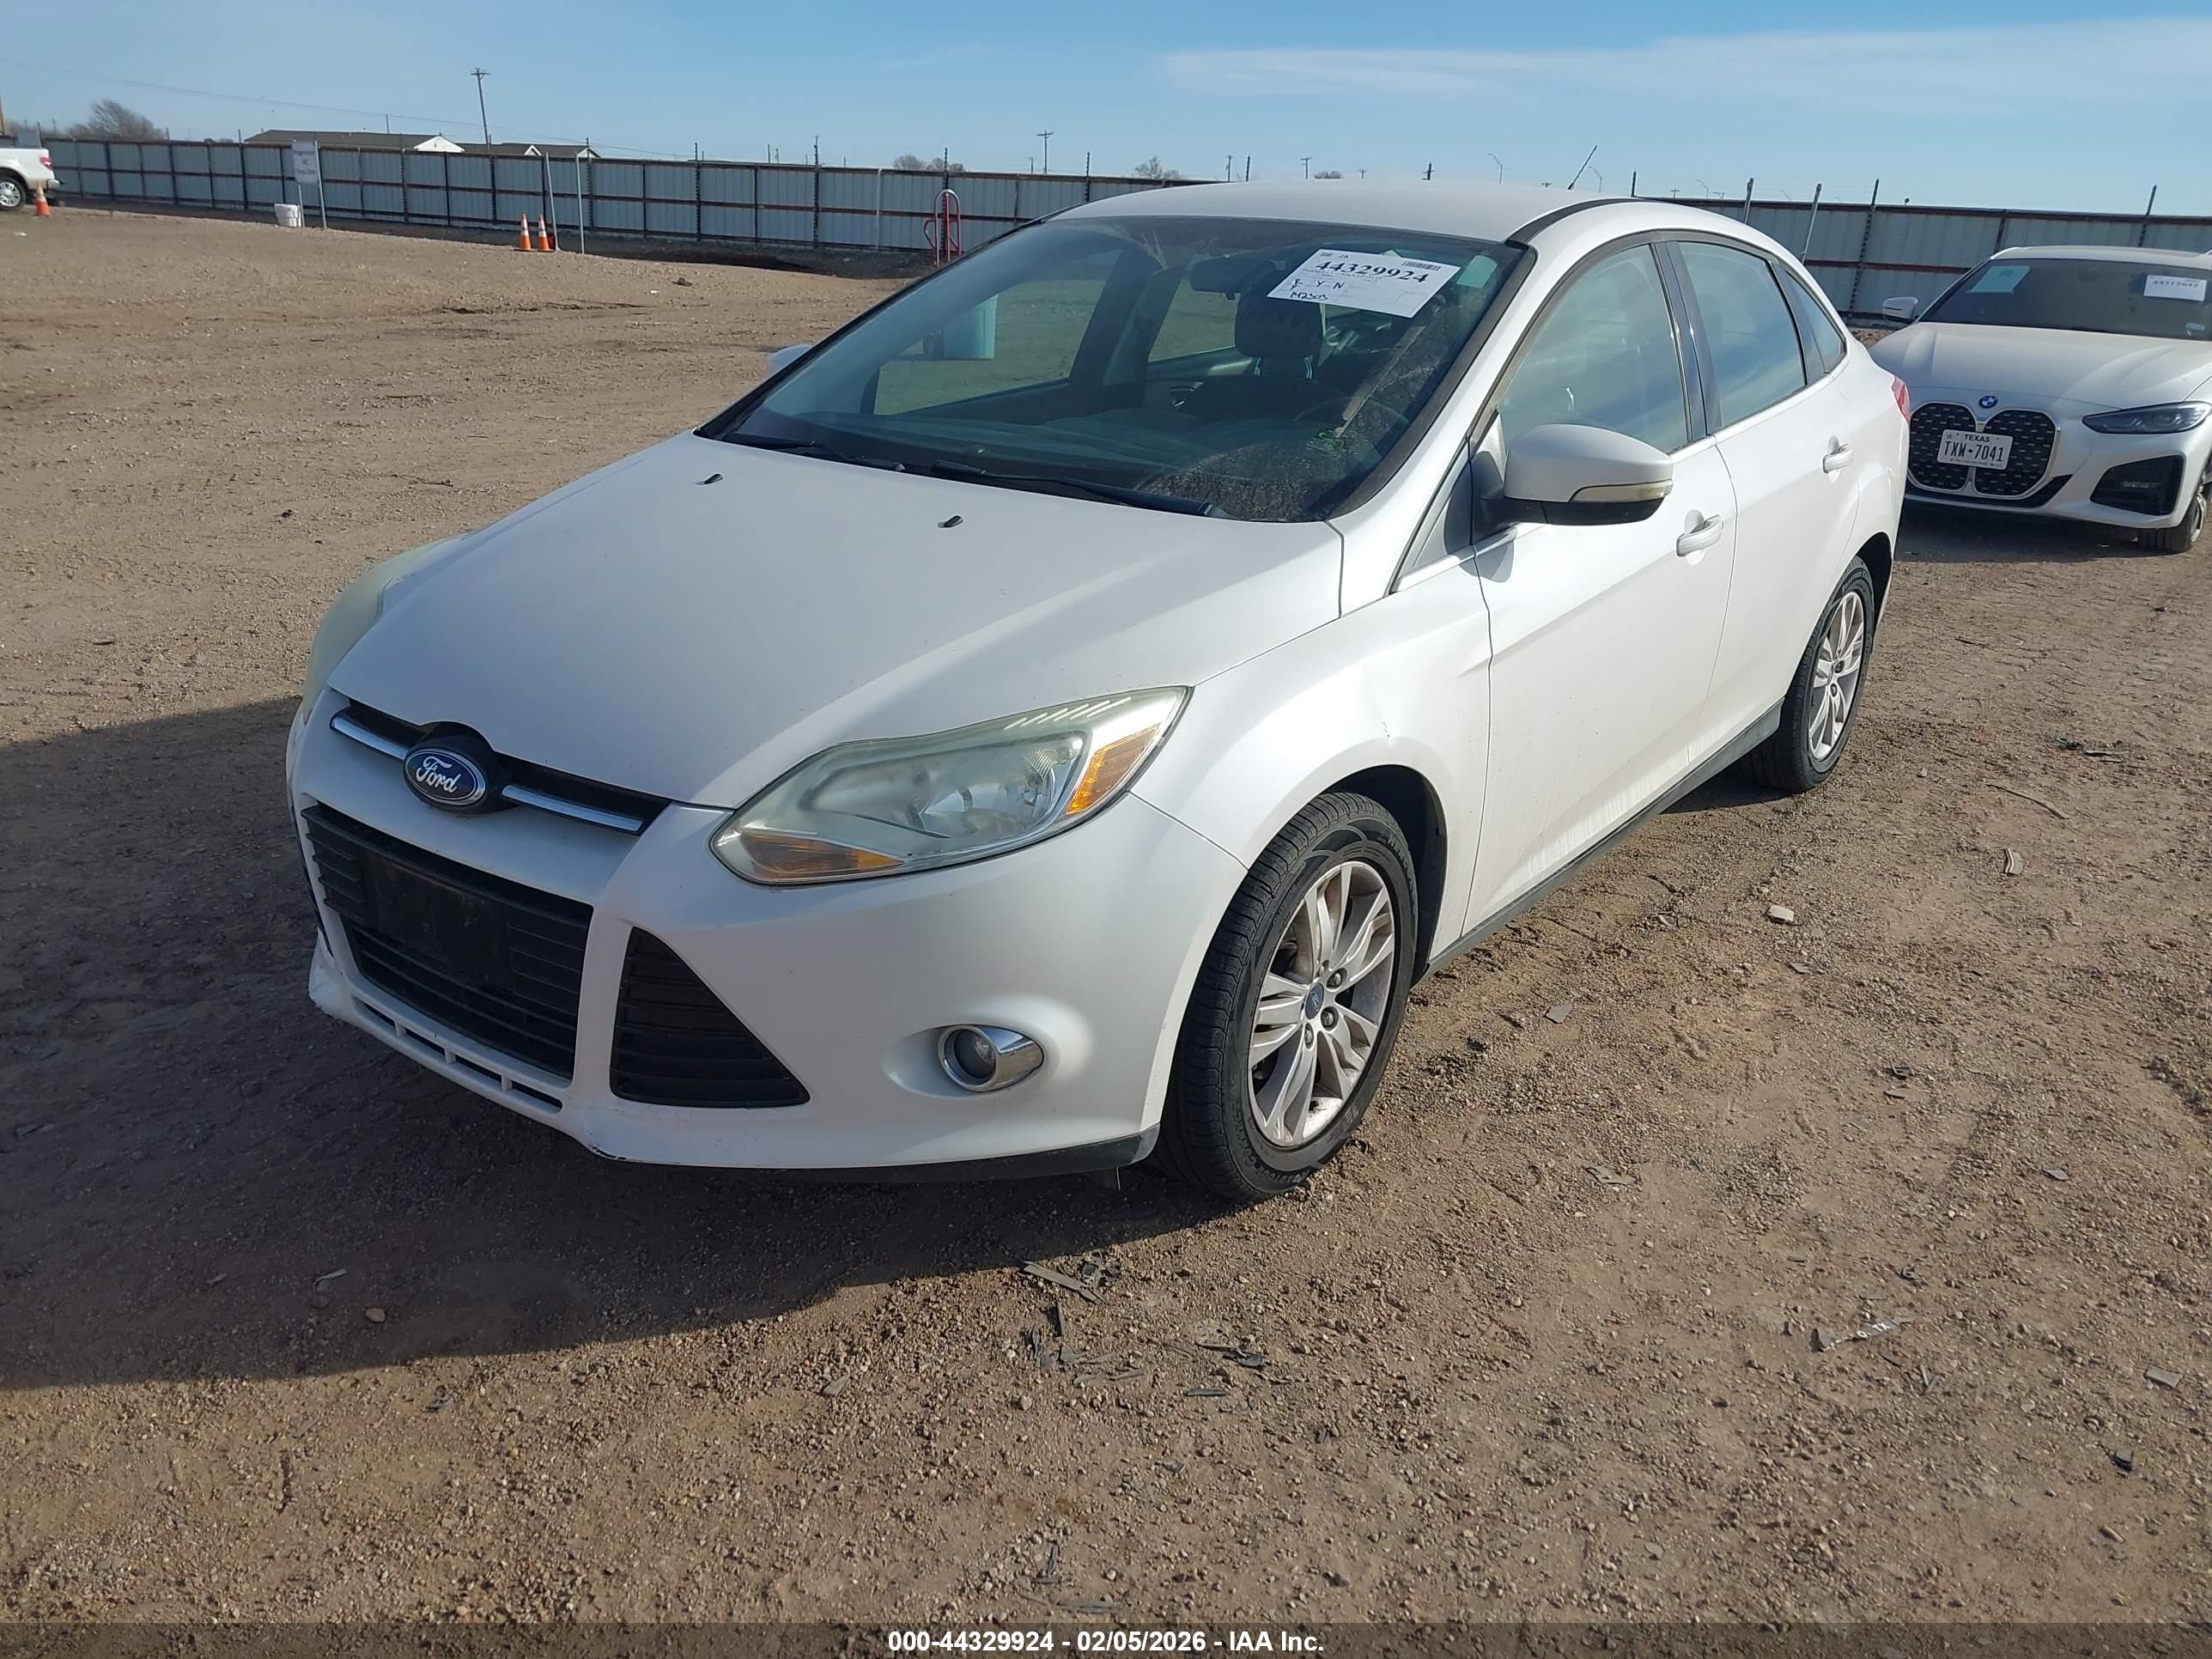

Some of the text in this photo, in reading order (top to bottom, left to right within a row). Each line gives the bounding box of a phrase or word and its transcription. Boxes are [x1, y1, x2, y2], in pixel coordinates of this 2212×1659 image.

[1316, 260, 1430, 283] 44329924
[1964, 434, 1990, 442] TEXAS
[416, 756, 462, 793] Ford
